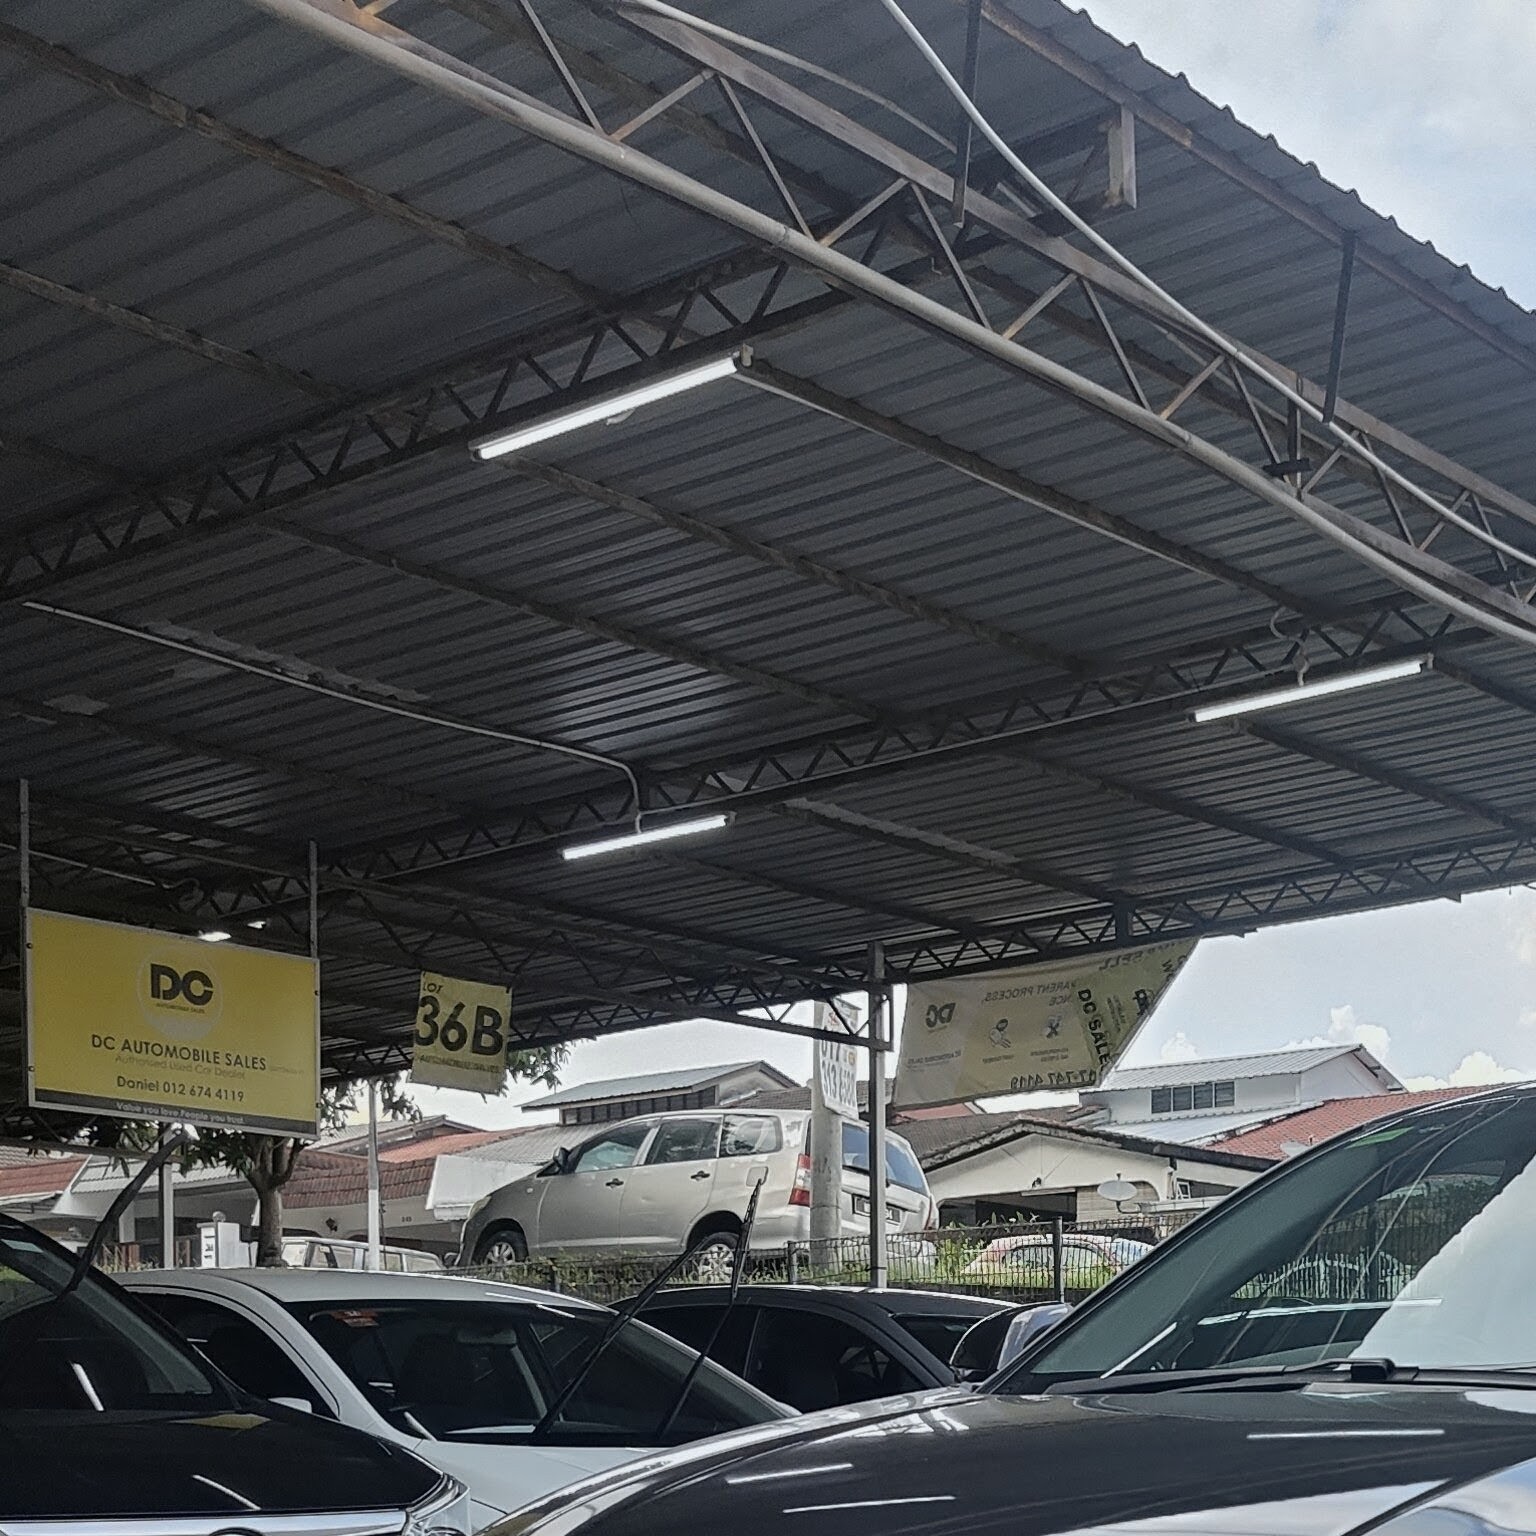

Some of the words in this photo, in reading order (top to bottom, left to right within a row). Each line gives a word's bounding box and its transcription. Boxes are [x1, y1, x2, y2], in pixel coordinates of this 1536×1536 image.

[150, 963, 214, 1006] DC
[423, 983, 443, 993] LOT
[416, 995, 503, 1056] 36B
[91, 1034, 116, 1050] DC
[121, 1039, 220, 1065] AUTOMOBILE
[225, 1053, 266, 1071] SALES
[117, 1075, 159, 1092] Daniel
[163, 1081, 186, 1095] 012
[189, 1085, 211, 1098] 674
[215, 1088, 244, 1102] 4119
